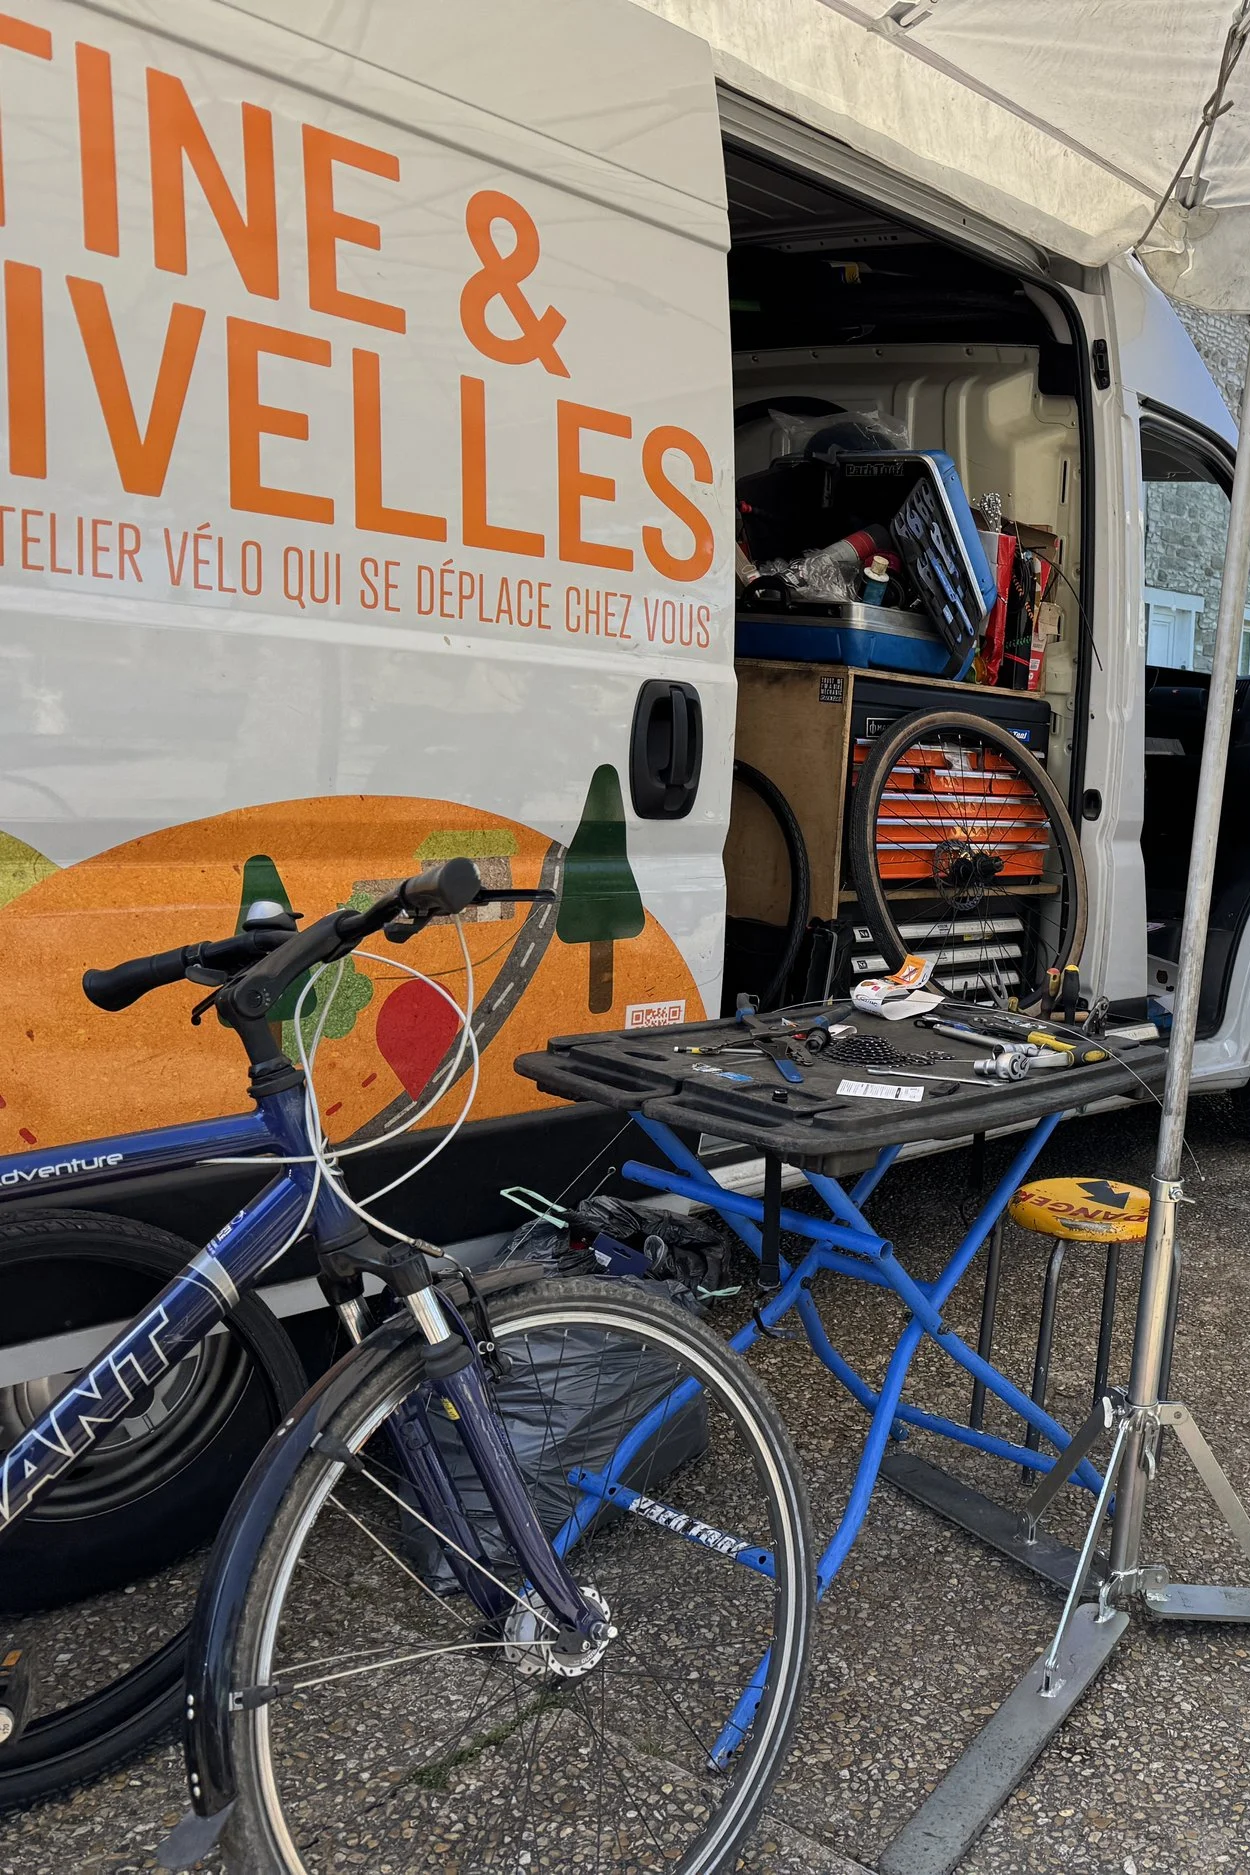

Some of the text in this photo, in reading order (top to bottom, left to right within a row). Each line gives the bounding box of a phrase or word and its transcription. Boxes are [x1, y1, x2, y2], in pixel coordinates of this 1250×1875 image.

[460, 190, 570, 378] &
[4, 259, 713, 582] IVELLES
[164, 521, 262, 597] VÉLO
[283, 546, 341, 609] QUI
[360, 557, 401, 612] SE
[417, 558, 552, 630] DÉPLACE
[565, 586, 632, 640] CHEZ
[643, 597, 711, 648] VOUS
[0, 1153, 123, 1187] dventure
[1018, 1189, 1149, 1223] DANGER
